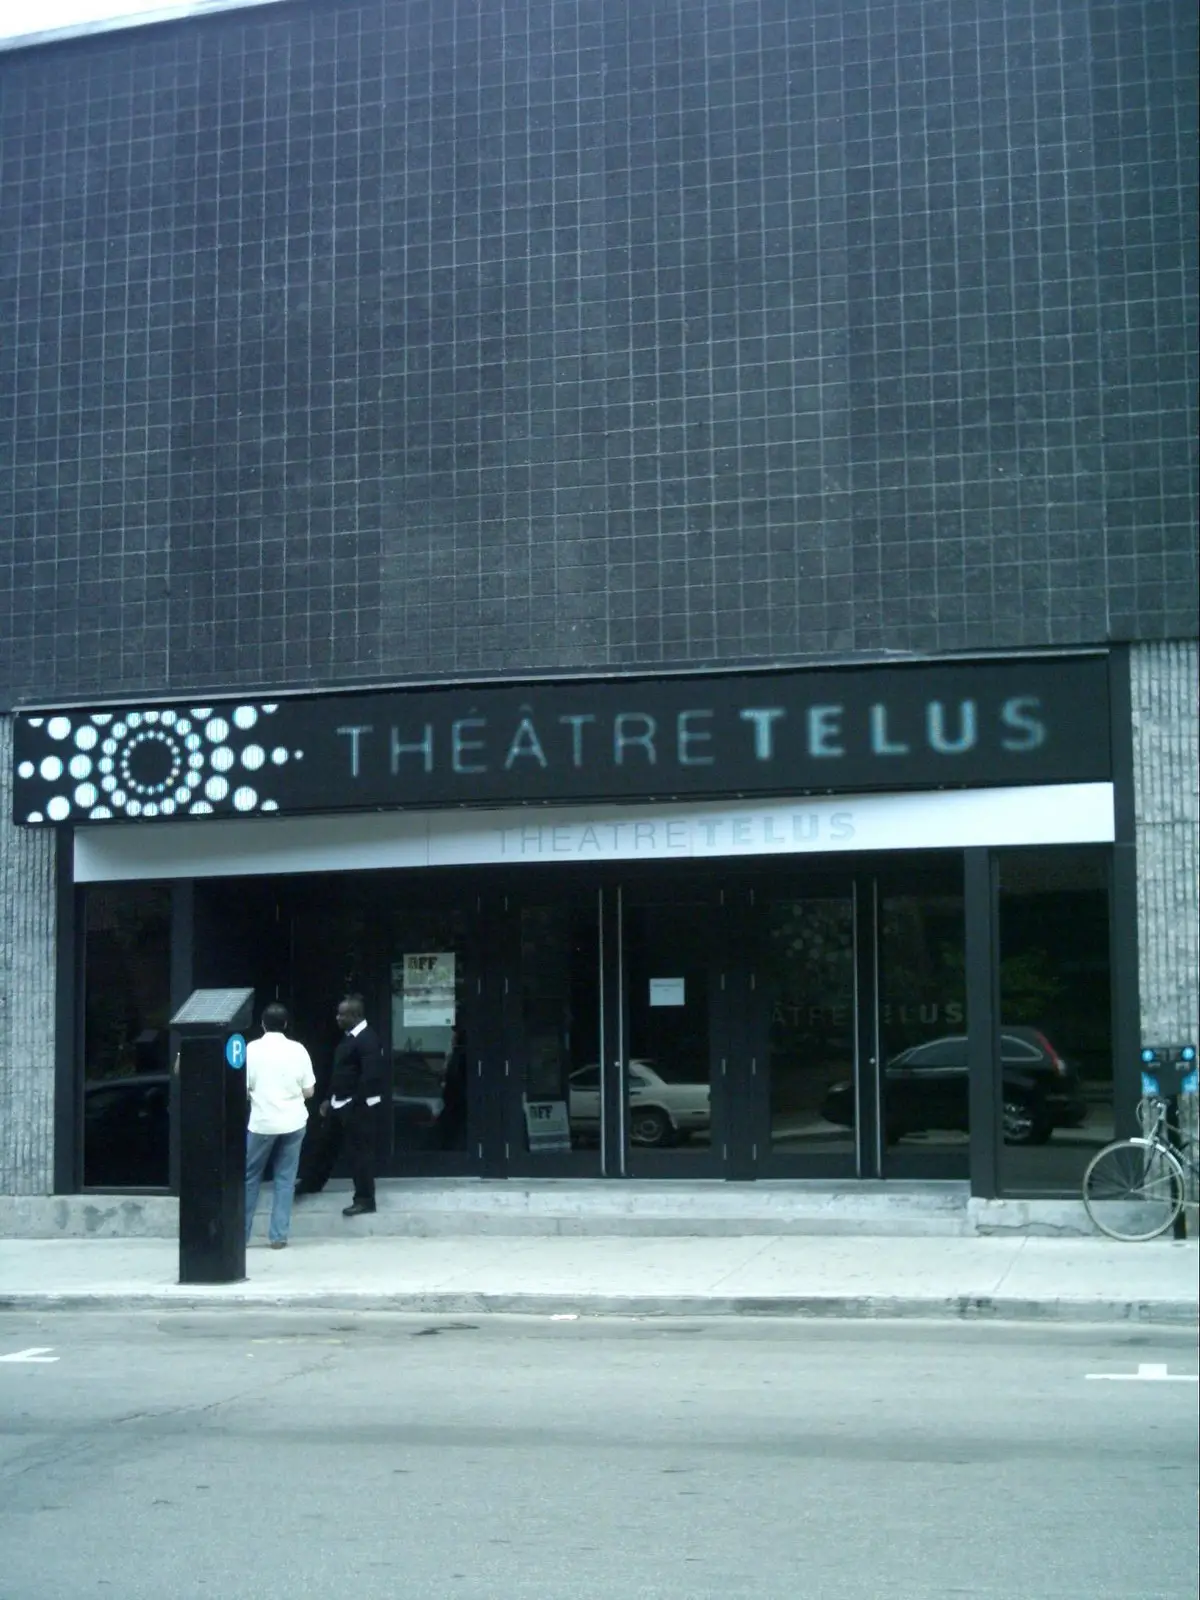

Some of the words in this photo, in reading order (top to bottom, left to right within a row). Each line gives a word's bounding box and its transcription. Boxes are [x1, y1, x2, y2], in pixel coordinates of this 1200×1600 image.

[336, 703, 714, 778] THÉÂTRE
[740, 695, 1046, 761] TELUS
[698, 811, 856, 846] TELUS
